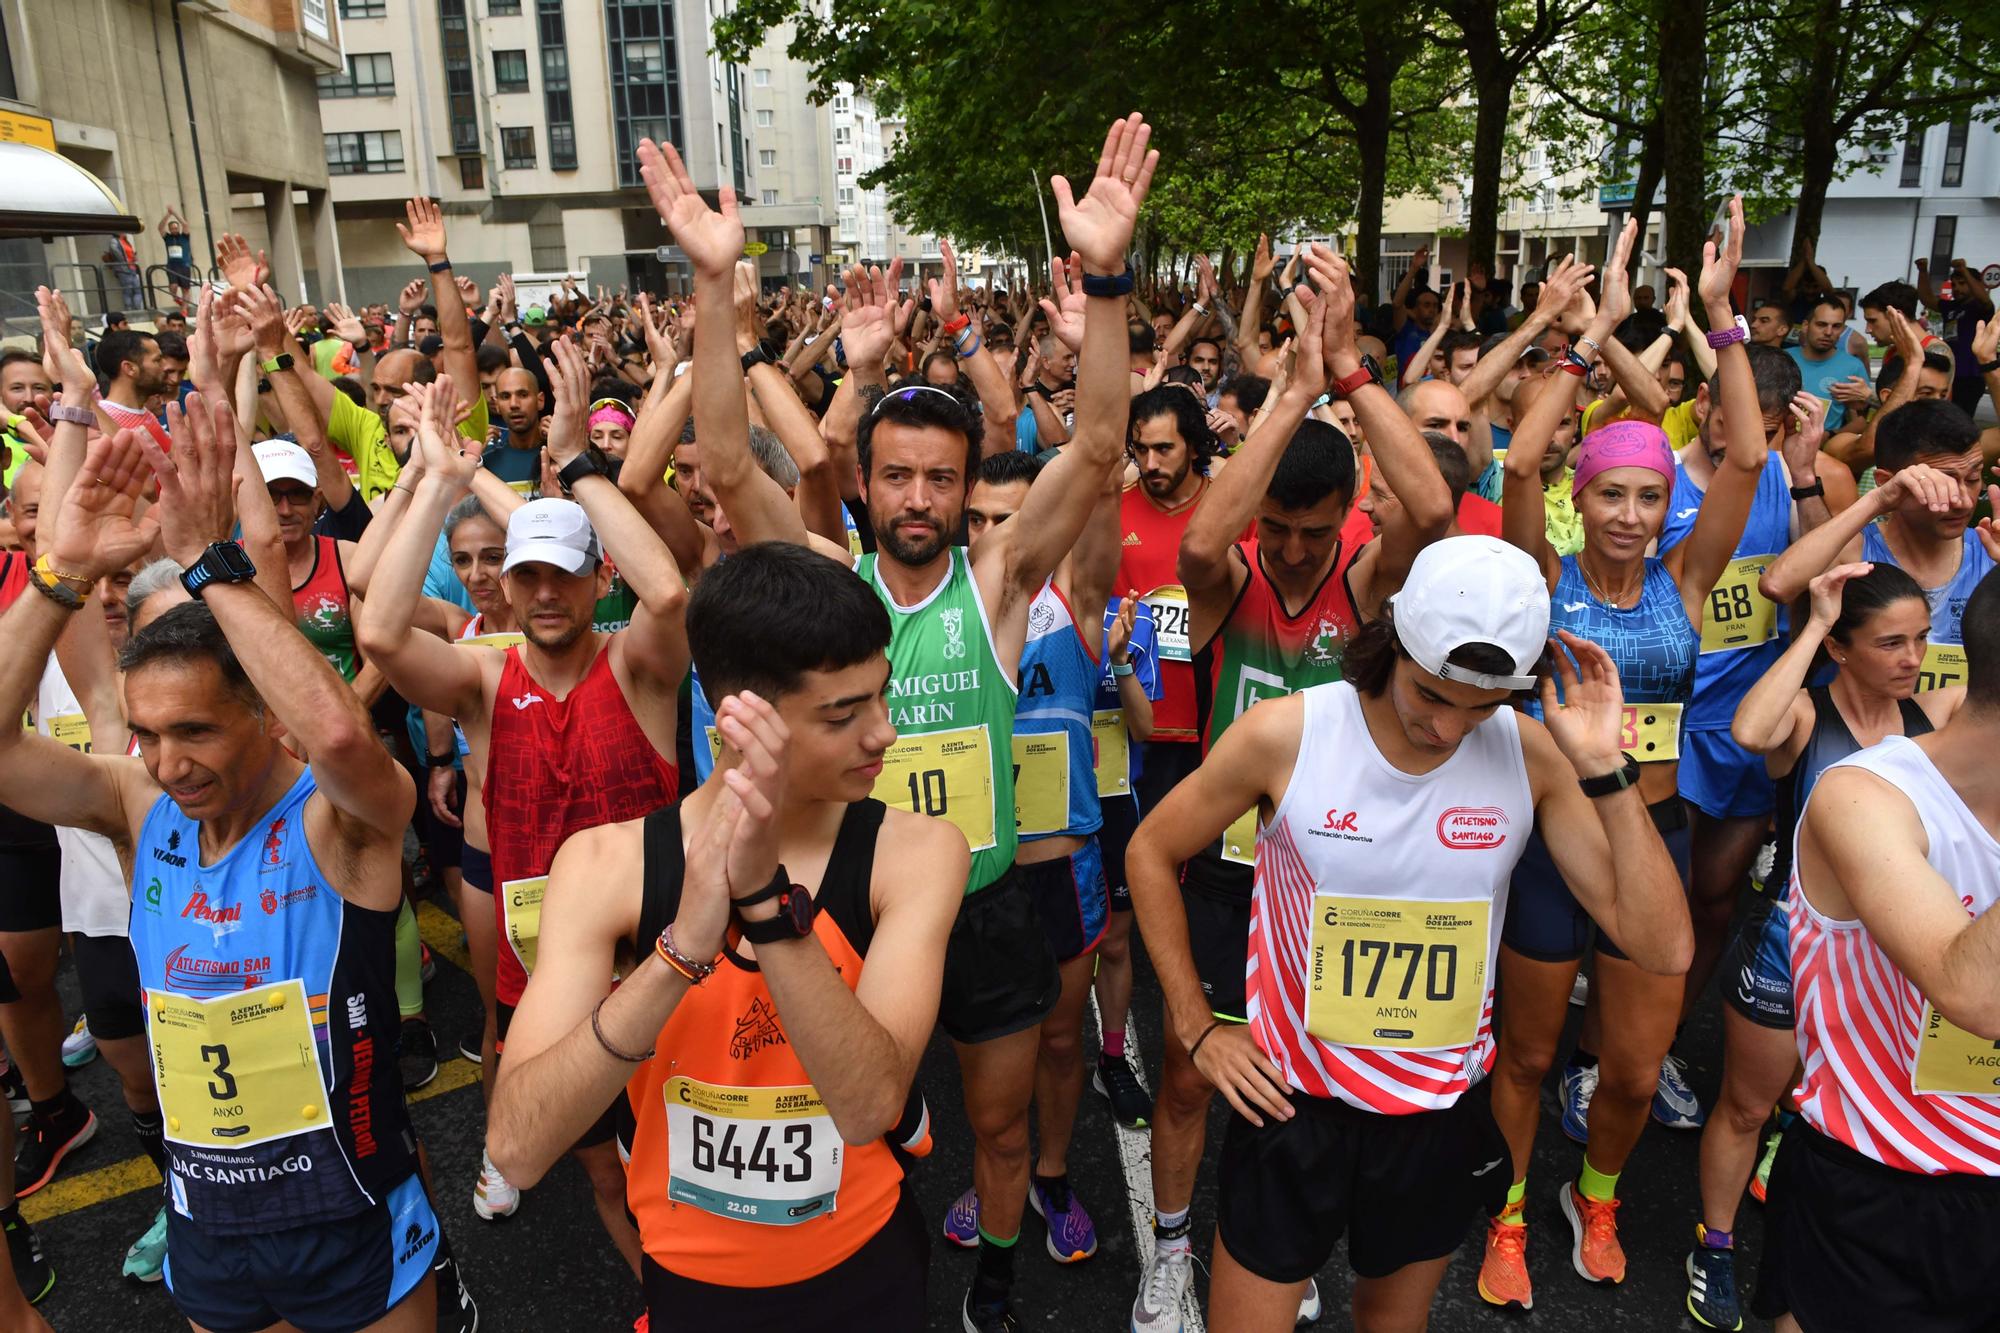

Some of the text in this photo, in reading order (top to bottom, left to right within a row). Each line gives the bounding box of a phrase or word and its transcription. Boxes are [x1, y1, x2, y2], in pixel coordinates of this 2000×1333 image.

[1710, 583, 1753, 622] 68
[1726, 623, 1746, 631] FRAN
[908, 769, 947, 817] 10
[1324, 809, 1358, 833] S&R
[1452, 817, 1497, 827] ATLETISMO
[1308, 828, 1373, 843] Orientación Deportiva
[1452, 831, 1494, 842] SANTIAGO
[181, 892, 243, 924] Peroni
[176, 956, 271, 974] ATLETISMO SAR
[1314, 944, 1324, 981] TANDA
[1341, 939, 1458, 1001] 1770
[1756, 975, 1790, 988] DEPORTE
[1756, 982, 1788, 994] GALEGO
[231, 1013, 248, 1022] DOS
[249, 1004, 285, 1018] BARRIOS
[237, 1003, 262, 1015] XENTE
[346, 992, 368, 1029] SAR
[1376, 1007, 1417, 1019] ANTÓN
[156, 1042, 166, 1079] TANDA
[201, 1044, 238, 1100] 3
[692, 1086, 749, 1102] CORUÑACORRE
[783, 1094, 808, 1102] XENTE
[213, 1104, 244, 1118] ANXO
[692, 1114, 812, 1182] 6443
[190, 1150, 256, 1164] S.INMOBILIARIOS
[172, 1154, 313, 1184] DAC SANTIAGO
[727, 1201, 758, 1215] 22.05
